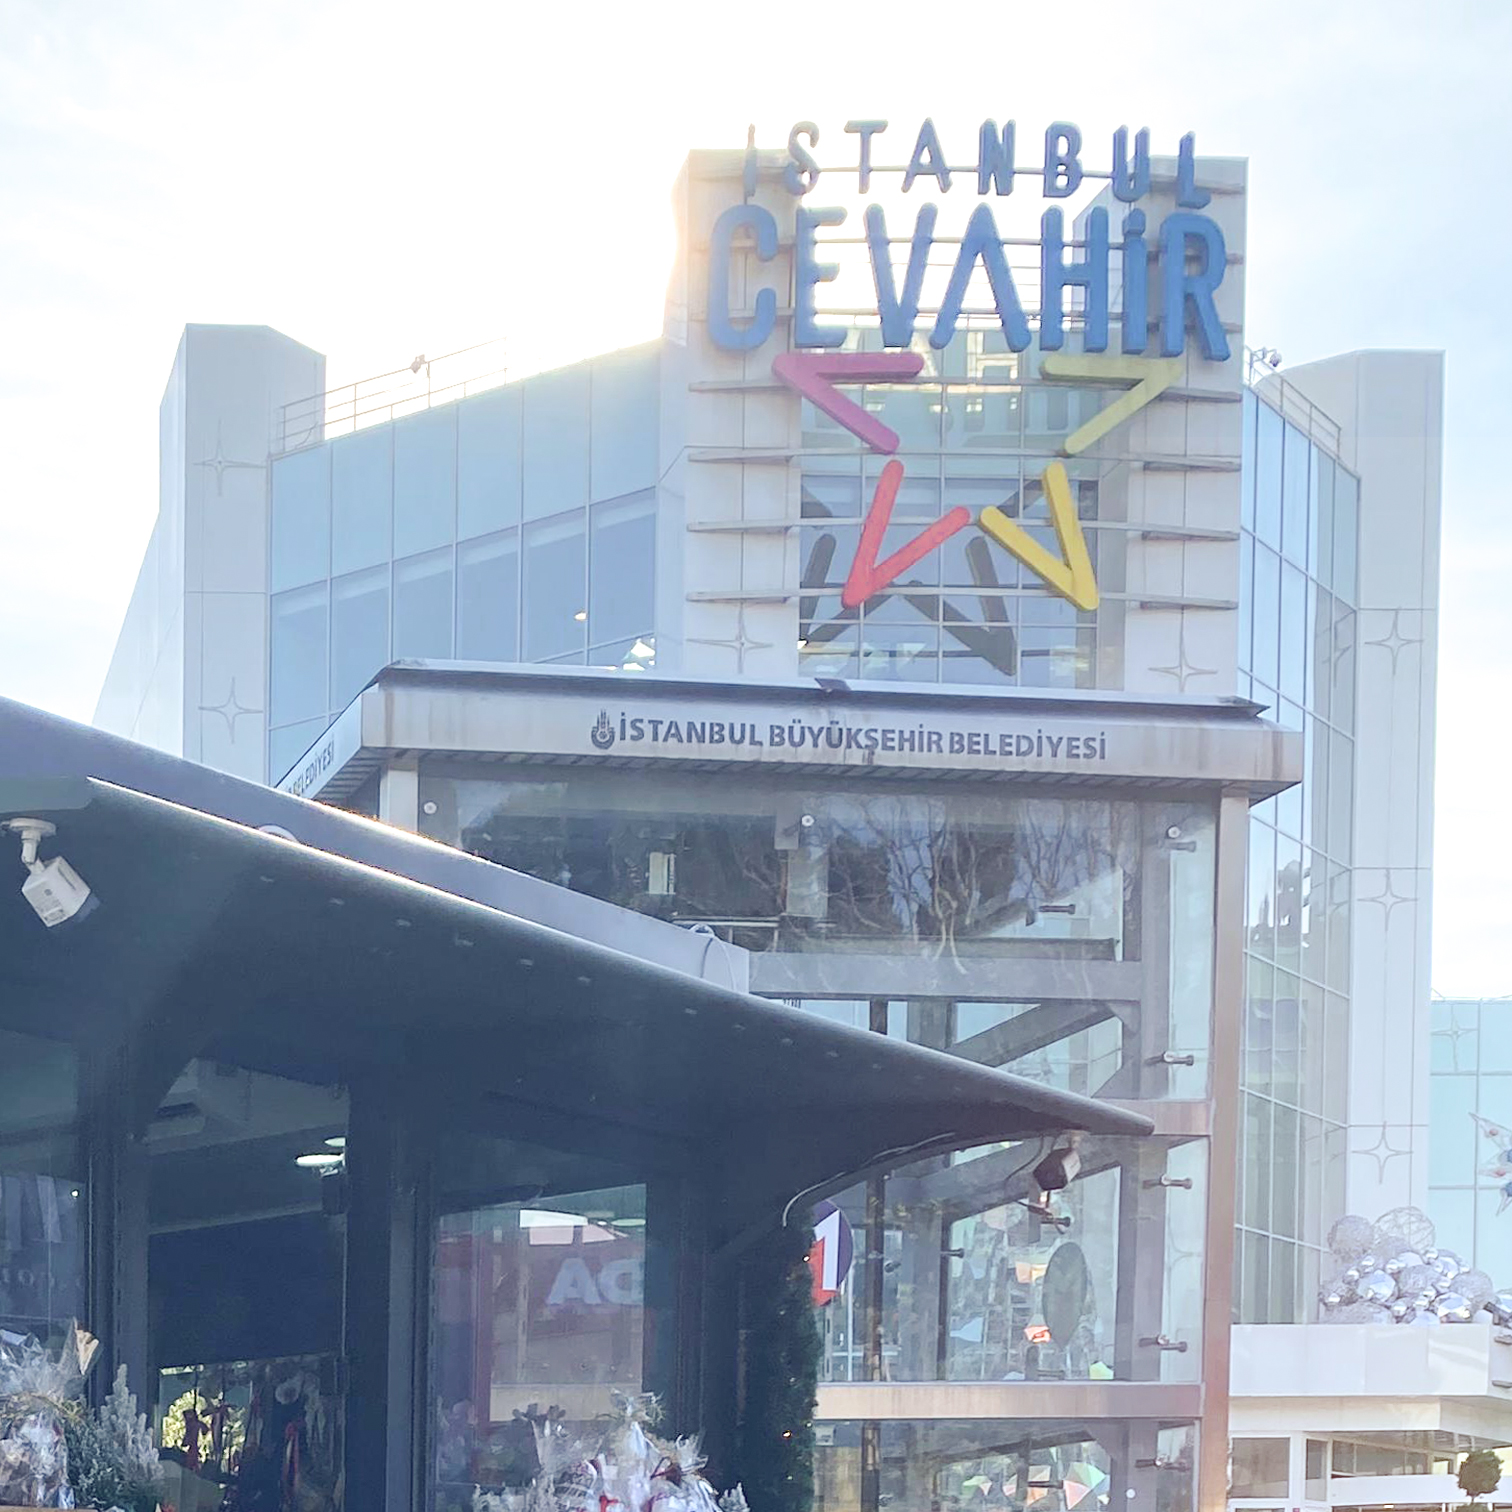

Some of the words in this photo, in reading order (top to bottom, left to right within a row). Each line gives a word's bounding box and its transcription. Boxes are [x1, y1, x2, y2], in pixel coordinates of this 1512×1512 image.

[705, 202, 1231, 362] CEVAHİR
[619, 712, 764, 747] İSTANBUL
[768, 719, 944, 756] BÜYÜKŞEHİR
[948, 728, 1107, 761] BELEDİYESİ
